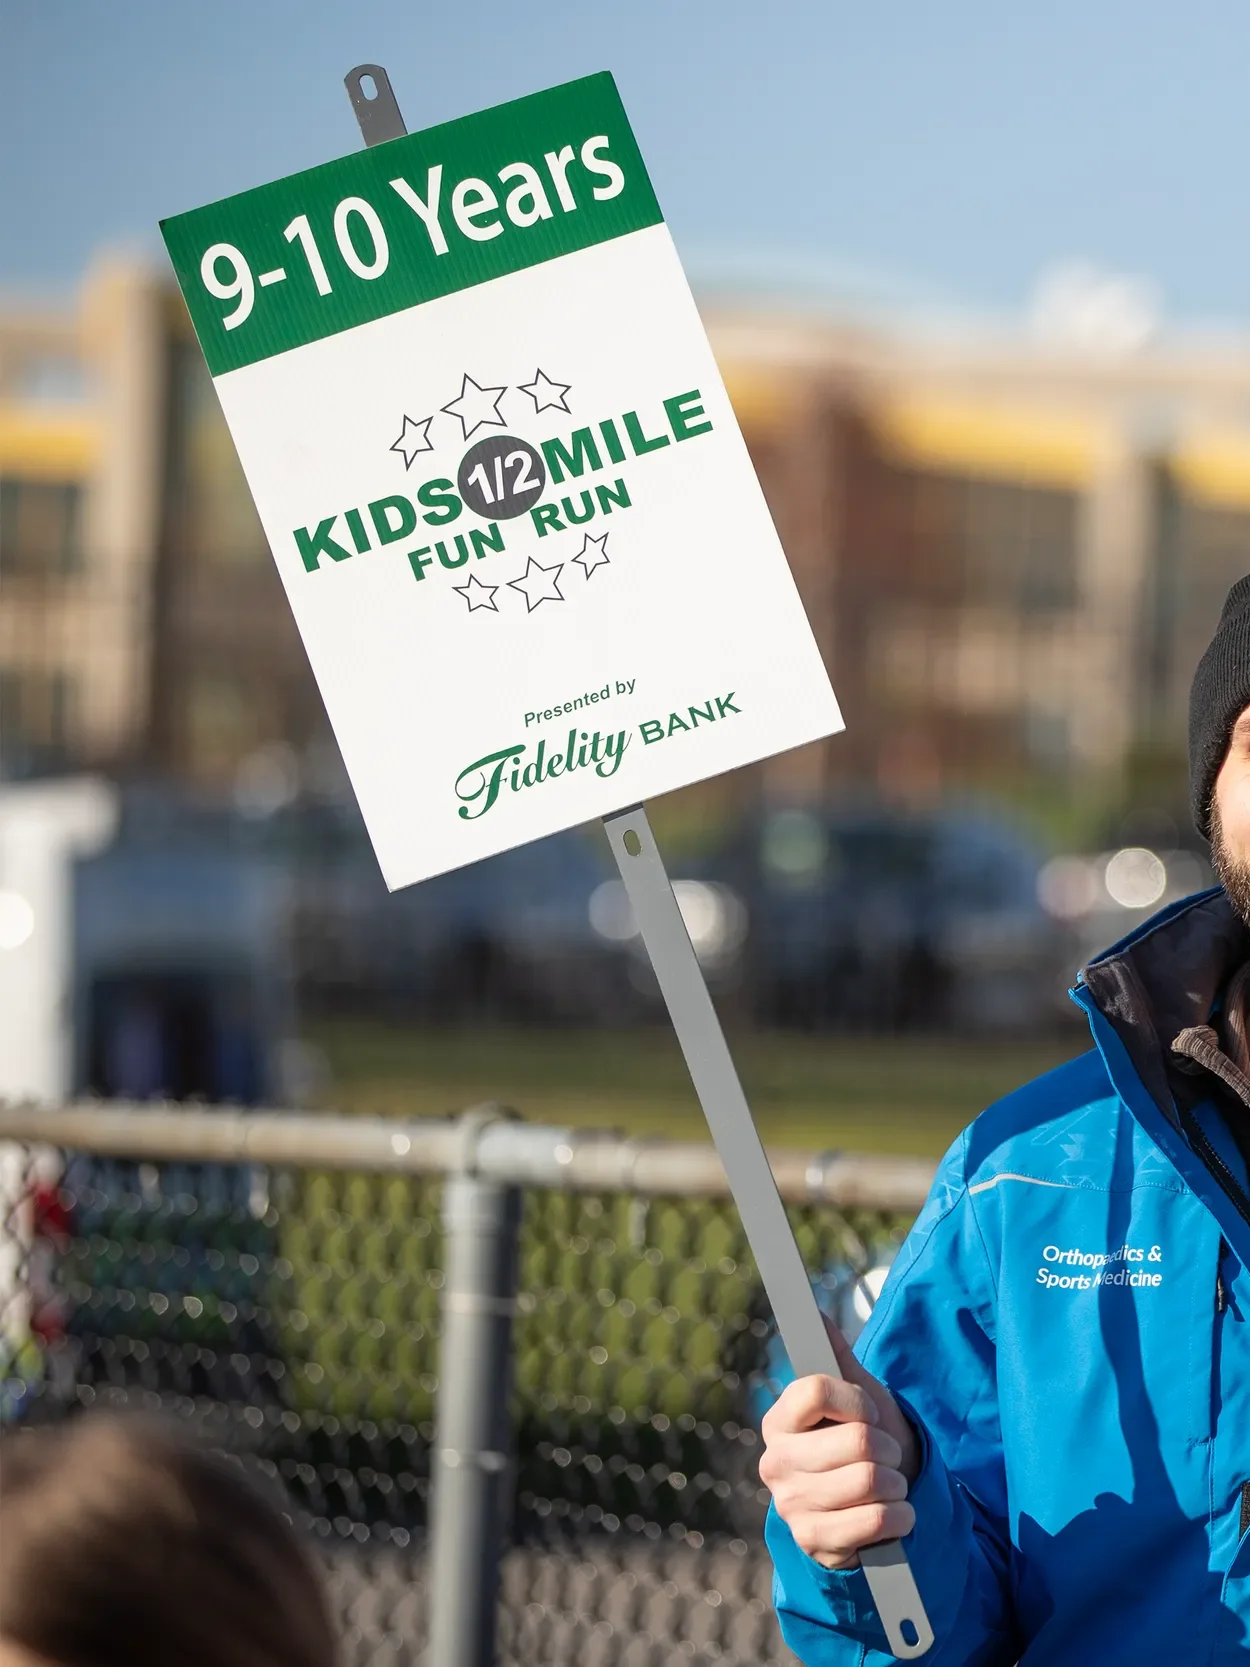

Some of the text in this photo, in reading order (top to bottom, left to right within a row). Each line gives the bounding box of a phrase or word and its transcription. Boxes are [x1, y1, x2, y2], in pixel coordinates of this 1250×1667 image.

[200, 135, 625, 331] 9-10 Years
[293, 389, 713, 572] KIDS 1/2 MILE
[408, 479, 631, 579] FUN RUN
[524, 679, 637, 728] Presented by
[454, 691, 743, 820] Fidelity BANK
[1035, 1267, 1162, 1289] Sports Medicine
[1042, 1244, 1162, 1270] Orthopaedics &
